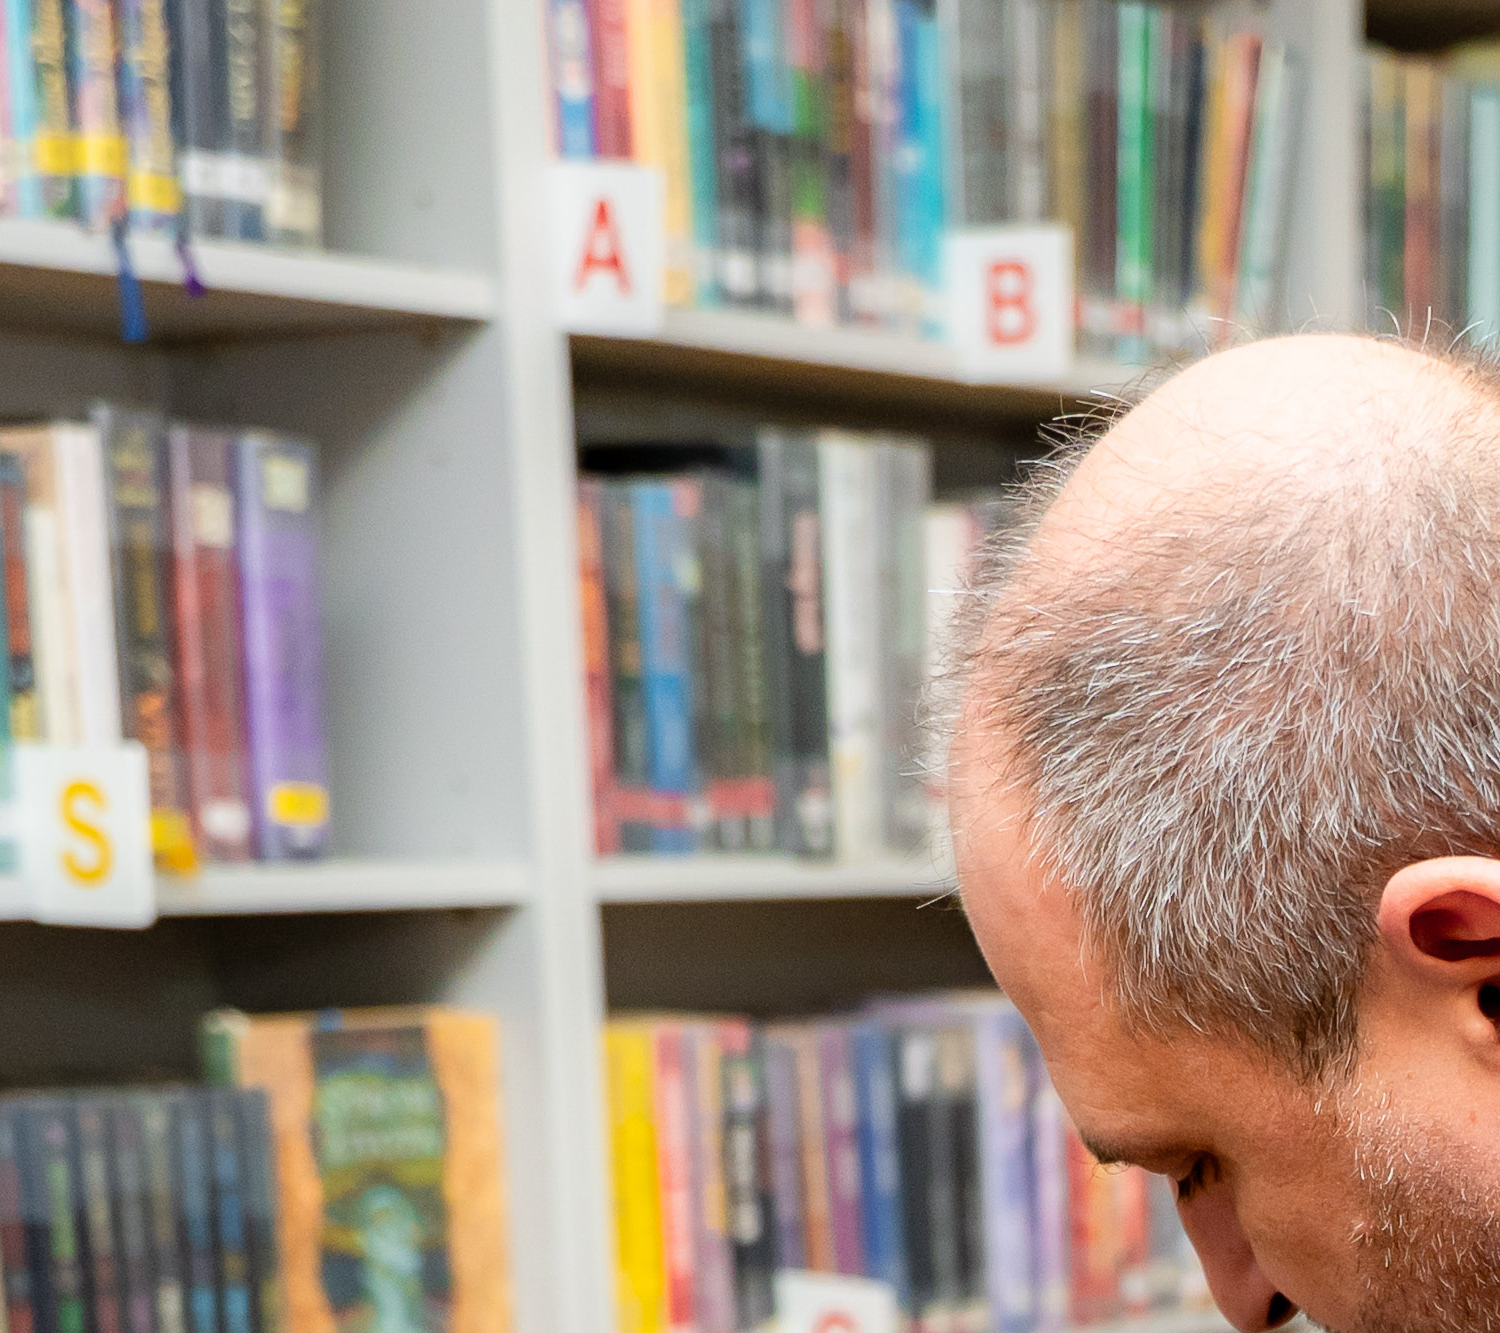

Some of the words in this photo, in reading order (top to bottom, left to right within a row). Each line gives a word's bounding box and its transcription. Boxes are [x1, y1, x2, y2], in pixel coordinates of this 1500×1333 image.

[573, 197, 632, 297] A
[983, 258, 1037, 348] B
[60, 778, 113, 886] S
